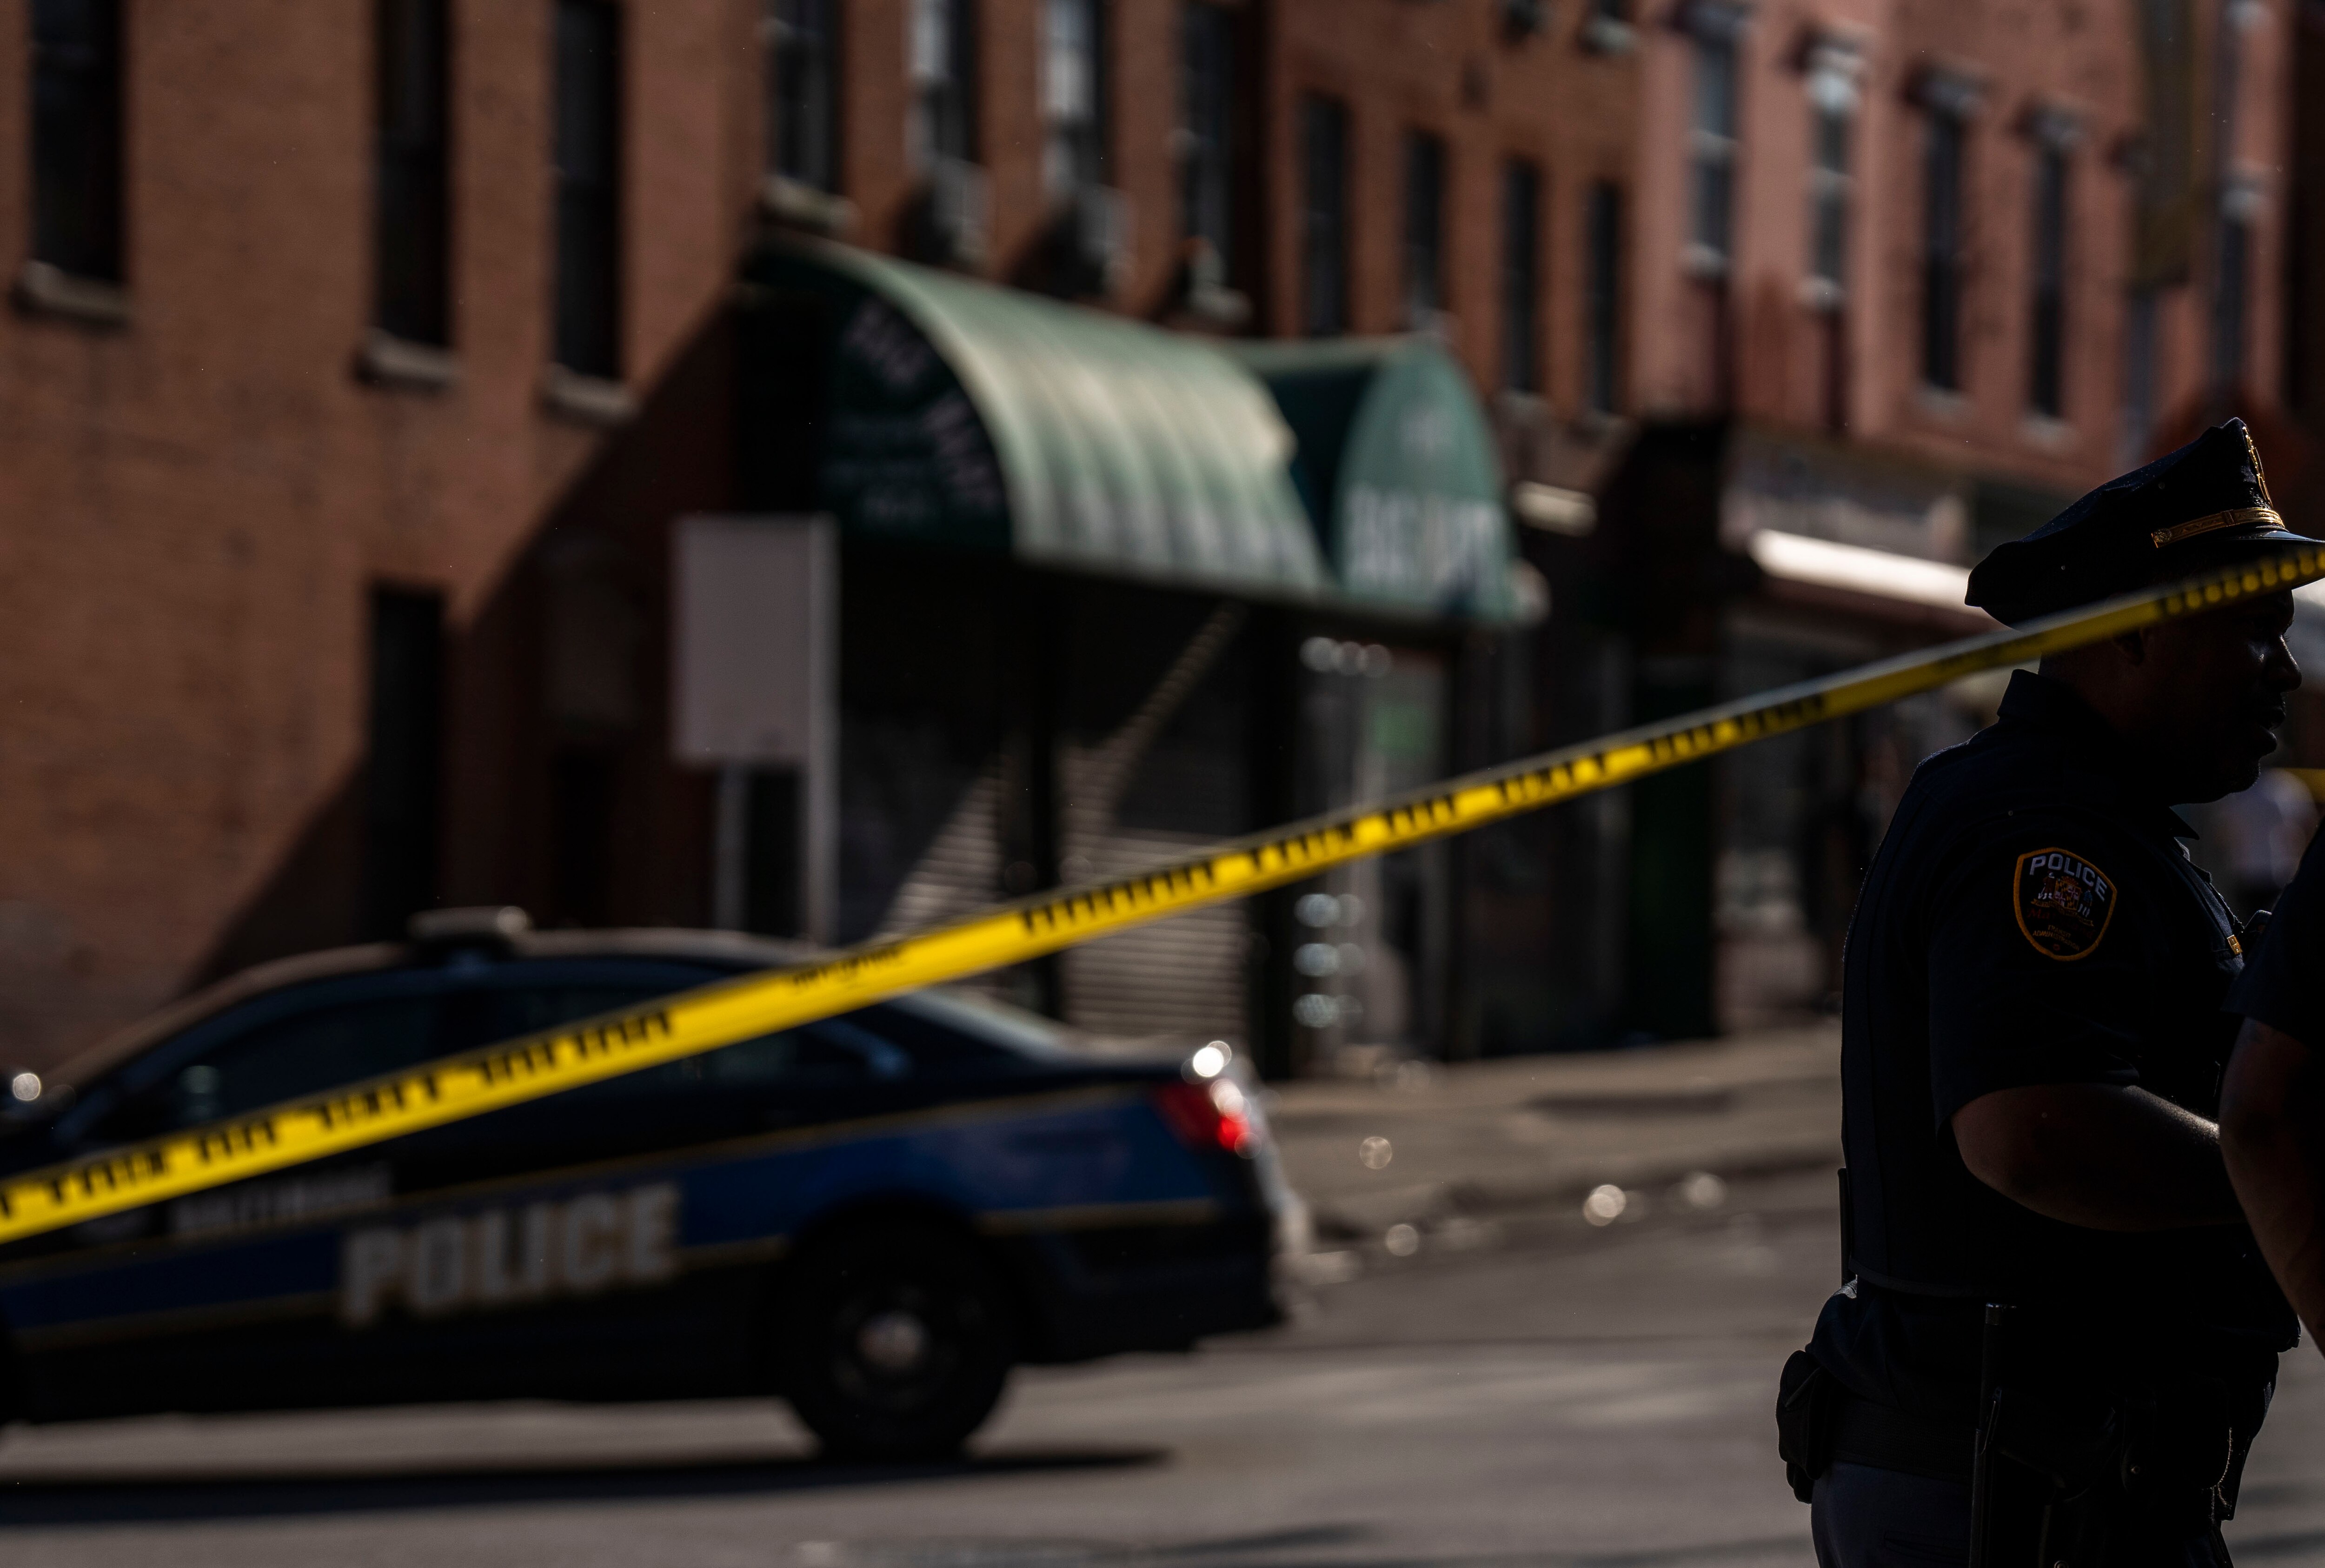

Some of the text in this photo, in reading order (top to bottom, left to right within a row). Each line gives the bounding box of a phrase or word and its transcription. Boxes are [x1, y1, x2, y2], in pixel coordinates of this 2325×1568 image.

[2029, 853, 2107, 903] POLICE
[2032, 930, 2080, 952] ADMINISTRATION
[2047, 924, 2072, 938] TRANSIT
[339, 1179, 683, 1331] POLICE
